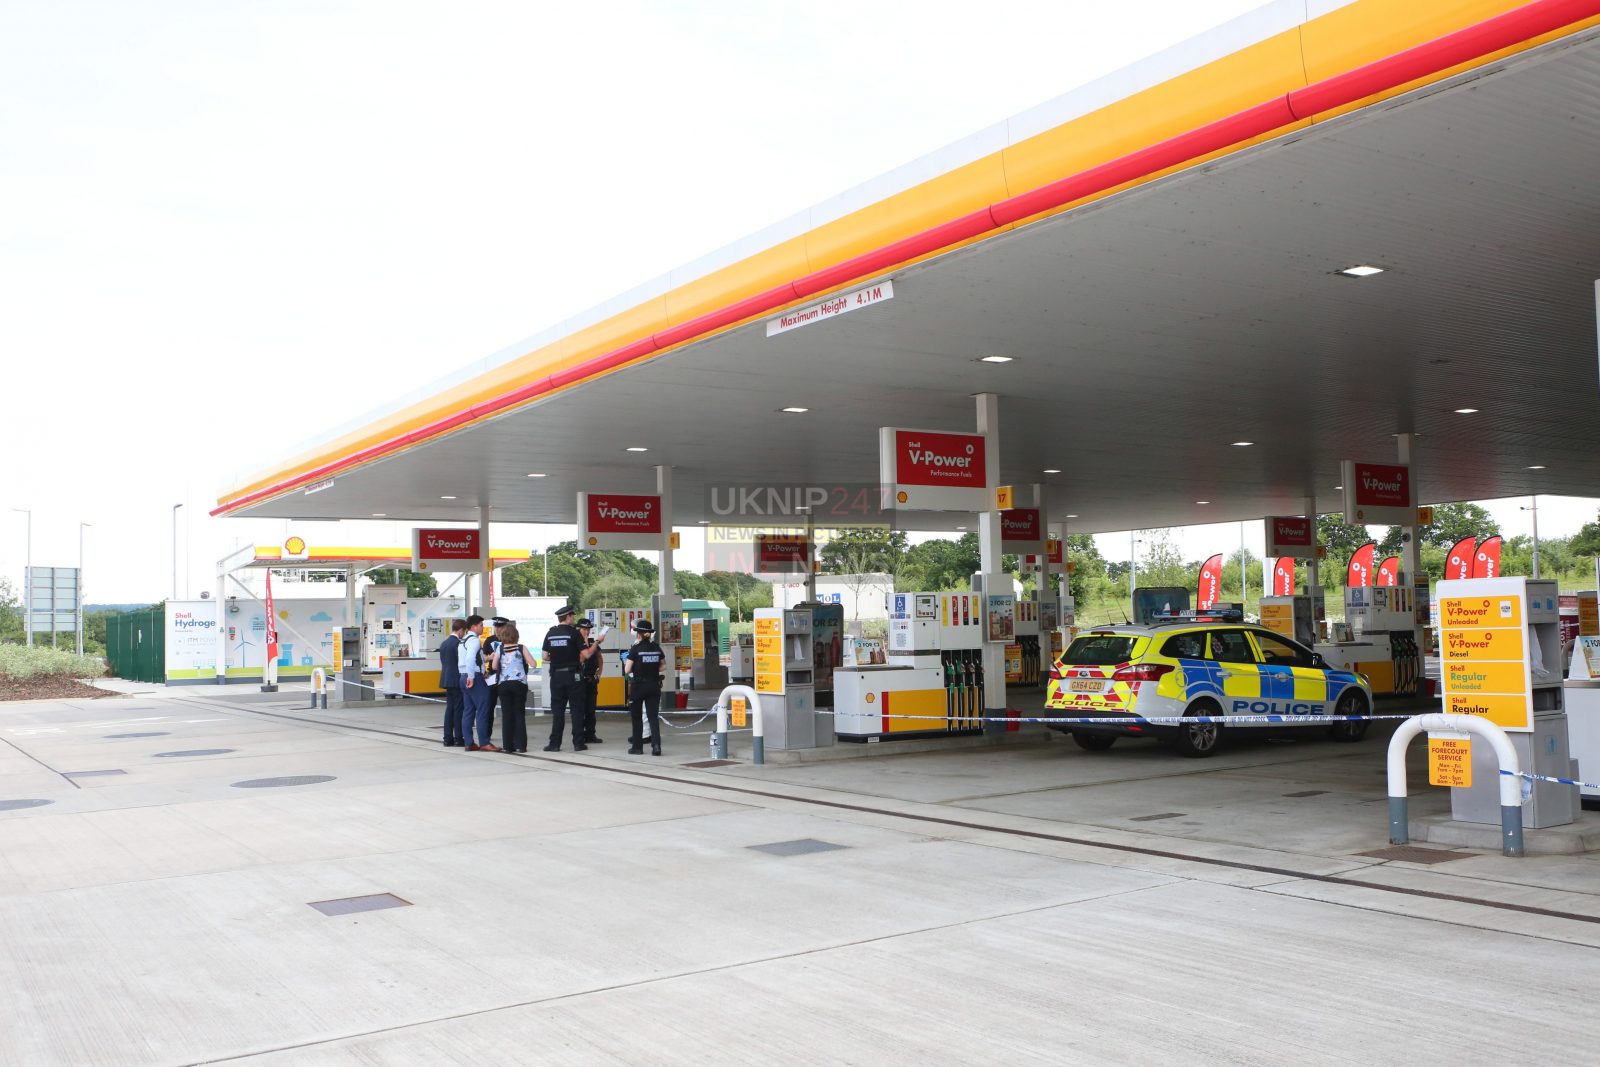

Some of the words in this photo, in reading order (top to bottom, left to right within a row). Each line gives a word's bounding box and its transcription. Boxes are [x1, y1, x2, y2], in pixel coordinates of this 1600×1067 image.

[780, 309, 818, 329] Maximum
[821, 298, 847, 315] Height
[909, 450, 972, 468] V-Power
[1363, 478, 1401, 492] V-Power
[998, 493, 1006, 503] 17
[598, 507, 650, 519] V-Power
[1279, 527, 1305, 536] V-Power
[427, 540, 470, 549] V-Power
[767, 544, 800, 552] V-Power
[1447, 607, 1487, 616] V-Power
[175, 619, 216, 629] Hydroge
[1447, 618, 1479, 626] Unleaded
[1449, 640, 1490, 648] V-Power
[1450, 672, 1487, 682] Regular
[1451, 682, 1482, 690] Unleaded
[1052, 700, 1117, 708] POLICE
[1232, 700, 1325, 716] POLICE
[1452, 704, 1489, 714] Regular
